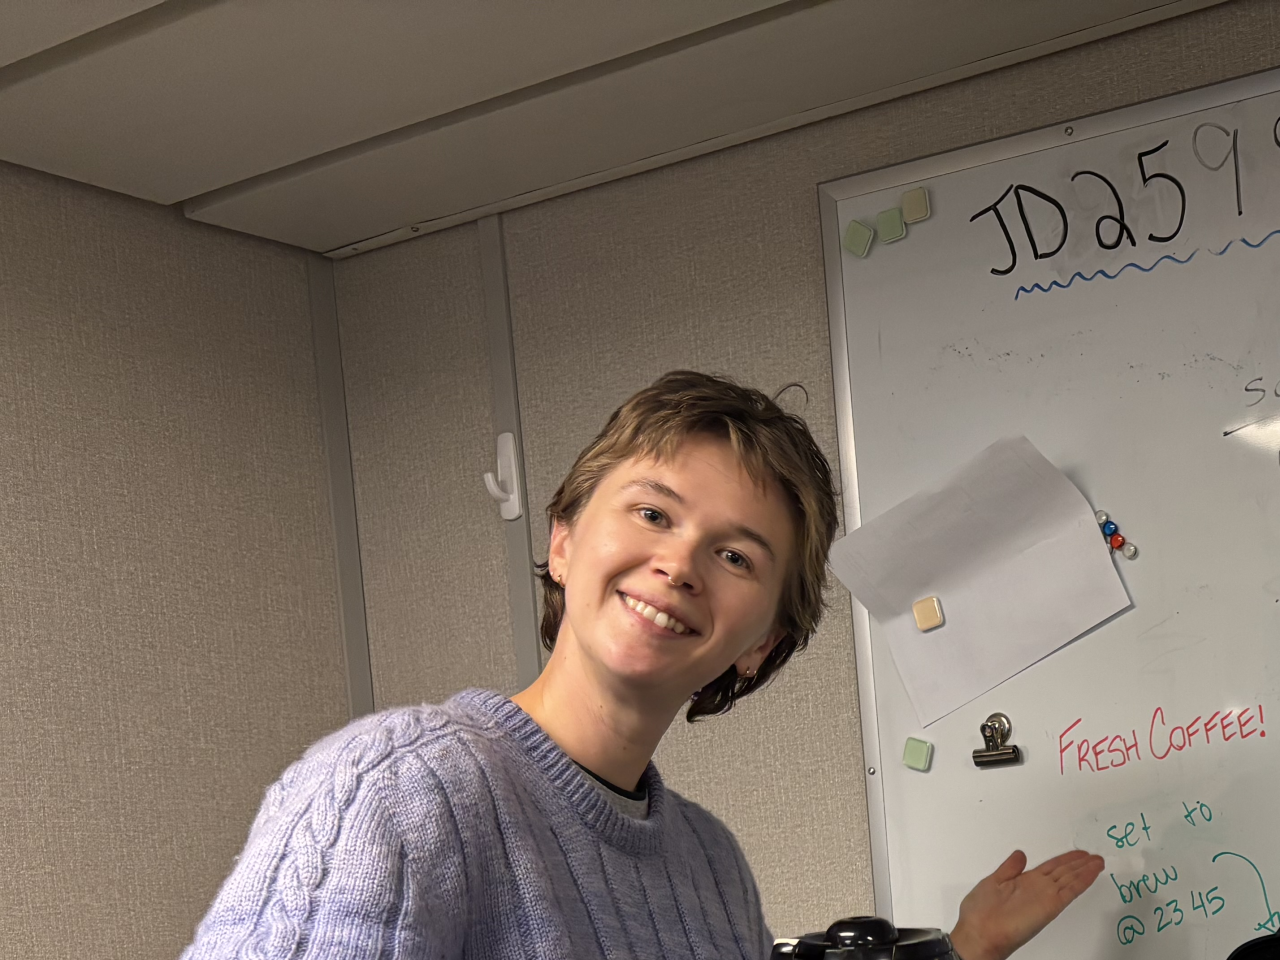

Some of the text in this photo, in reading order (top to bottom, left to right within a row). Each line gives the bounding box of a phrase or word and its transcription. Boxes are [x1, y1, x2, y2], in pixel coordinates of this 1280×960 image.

[1058, 704, 1267, 776] FRESH COFFEE!
[1106, 801, 1214, 849] set to
[1110, 864, 1179, 905] brew
